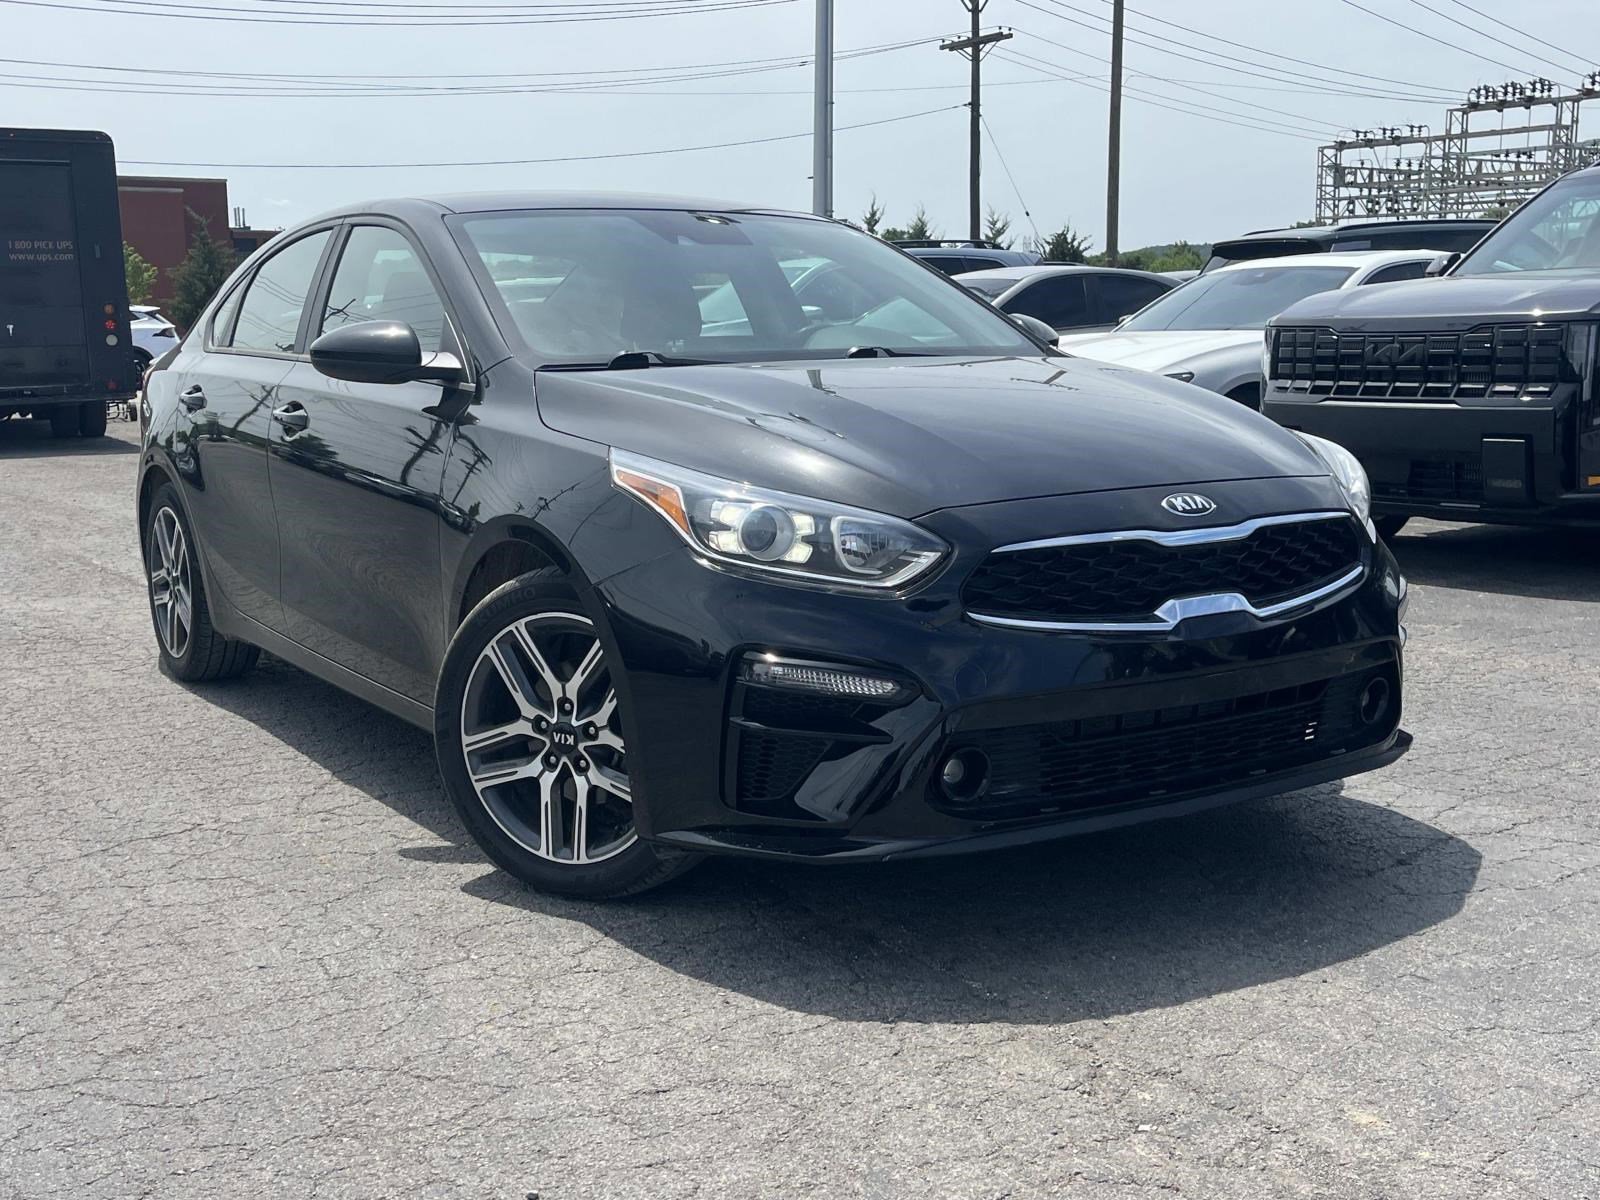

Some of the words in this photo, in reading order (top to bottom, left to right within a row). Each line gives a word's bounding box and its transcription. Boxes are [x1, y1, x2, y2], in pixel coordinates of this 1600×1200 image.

[15, 240, 32, 249] 800
[34, 240, 55, 249] PICK
[56, 240, 73, 249] UPS
[8, 253, 74, 262] www.ups.com
[1169, 495, 1211, 511] KIA
[552, 731, 575, 746] KIA
